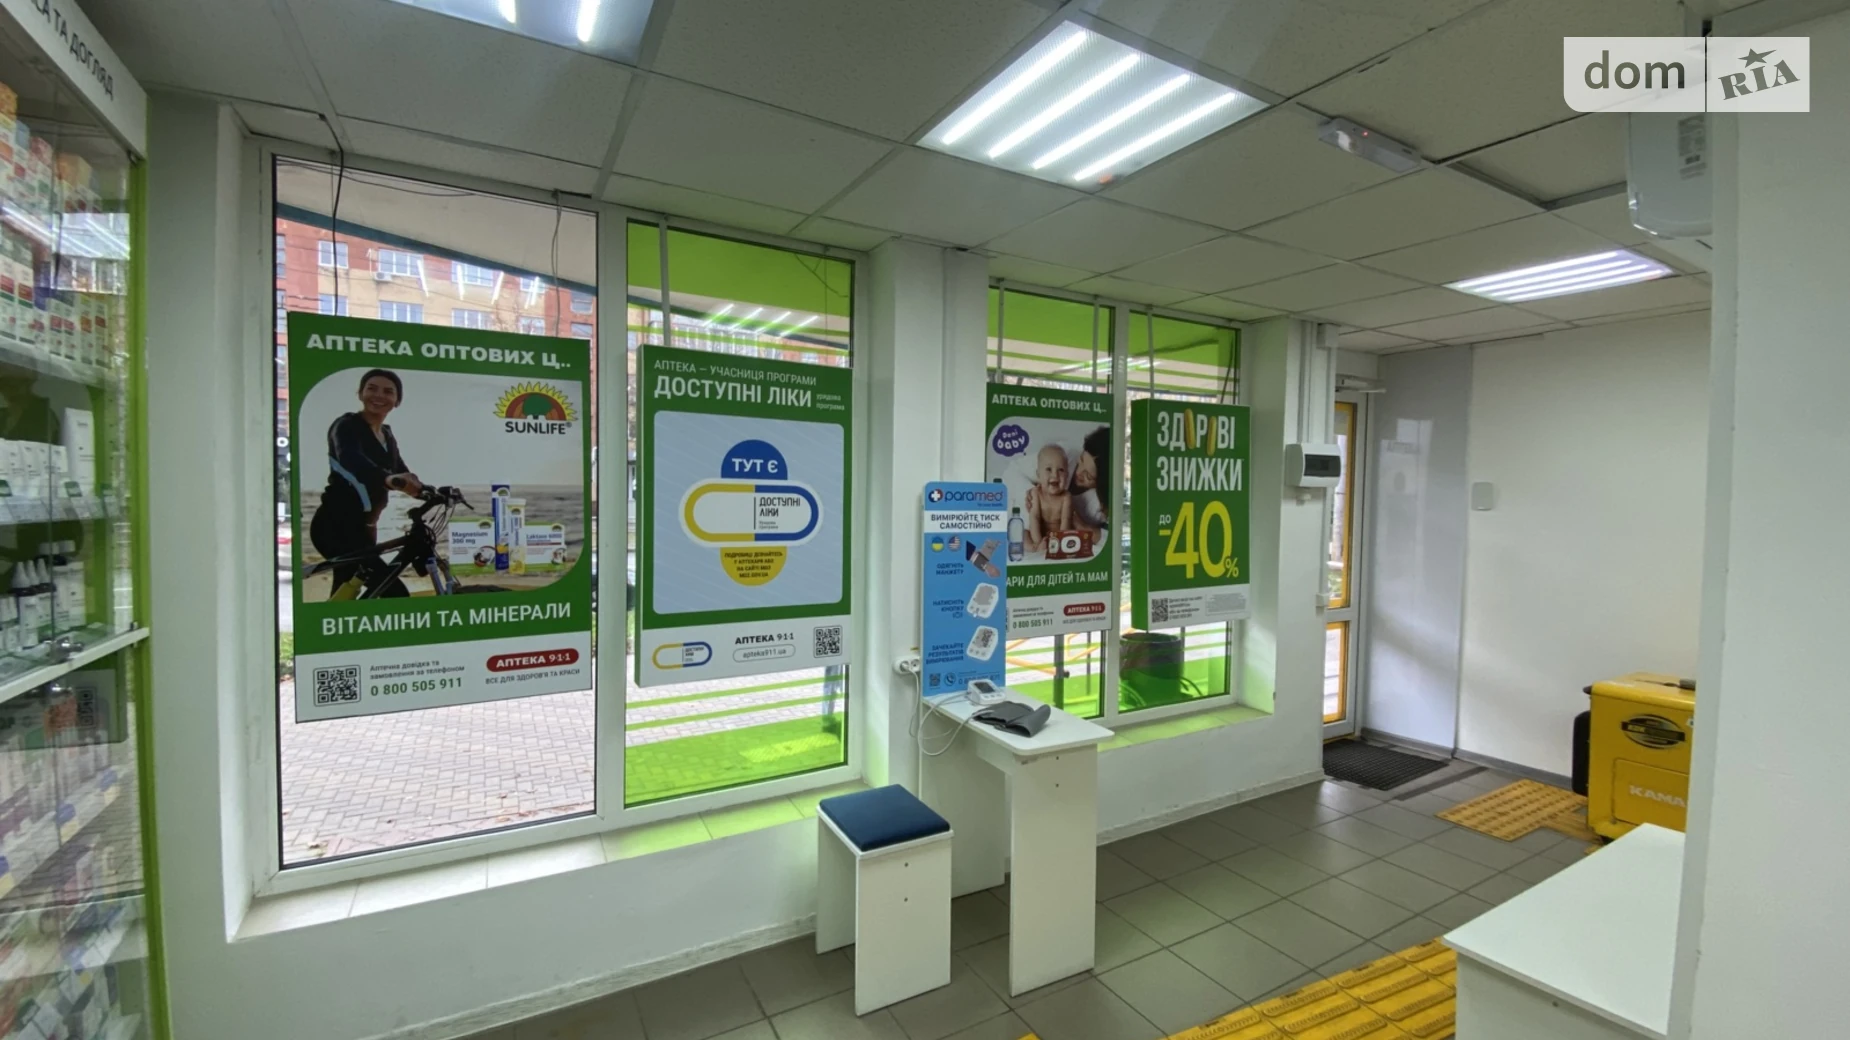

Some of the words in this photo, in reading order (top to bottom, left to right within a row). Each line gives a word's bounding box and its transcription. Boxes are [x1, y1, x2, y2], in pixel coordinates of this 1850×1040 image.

[53, 8, 69, 44] ТА
[69, 32, 114, 102] ДОГЛЯД
[306, 333, 414, 356] АПТЕКА
[420, 342, 535, 365] ОПТОВИХ
[654, 359, 697, 374] АПТЕКА
[710, 365, 765, 381] УЧАСНИЦЯ
[766, 371, 817, 386] ПРОГРАМИ
[654, 375, 762, 404] ДОСТУПНІ
[767, 386, 812, 408] ЛІКИ
[991, 394, 1038, 407] АПТЕКА
[1040, 398, 1091, 411] ОПТОВИХ
[997, 436, 1025, 449] baby
[732, 458, 764, 473] ТУТ
[767, 460, 778, 473] Є
[1156, 456, 1242, 491] ЗНИЖКИ
[759, 497, 801, 507] ДОСТУПНІ
[944, 491, 1003, 502] paramed
[759, 508, 779, 517] ЛІКИ
[931, 513, 978, 521] ВИМІРЮЙТЕ
[939, 520, 992, 529] САМОСТІЙНО
[1026, 575, 1046, 588] ДЛЯ
[1048, 571, 1074, 586] ДІТЕЙ
[1075, 572, 1086, 582] ТА
[1087, 571, 1108, 582] МАМ
[322, 611, 431, 636] ВІТАМІНИ
[437, 610, 463, 627] ТА
[469, 602, 571, 625] МІНЕРАЛИ
[1043, 618, 1053, 626] 911
[735, 635, 775, 645] АПТЕКА
[369, 663, 400, 672] Аптечна
[401, 661, 430, 671] довідка
[496, 655, 546, 668] АПТЕКА
[369, 671, 414, 680] замовлення
[425, 665, 465, 677] телефоном
[485, 677, 499, 685] ВСЕ
[499, 676, 515, 685] ДЛЯ
[549, 670, 558, 678] ТА
[559, 668, 580, 677] КРАСИ
[370, 685, 379, 696] 0
[383, 682, 408, 696] 800
[411, 679, 436, 693] 505
[439, 677, 462, 690] 911
